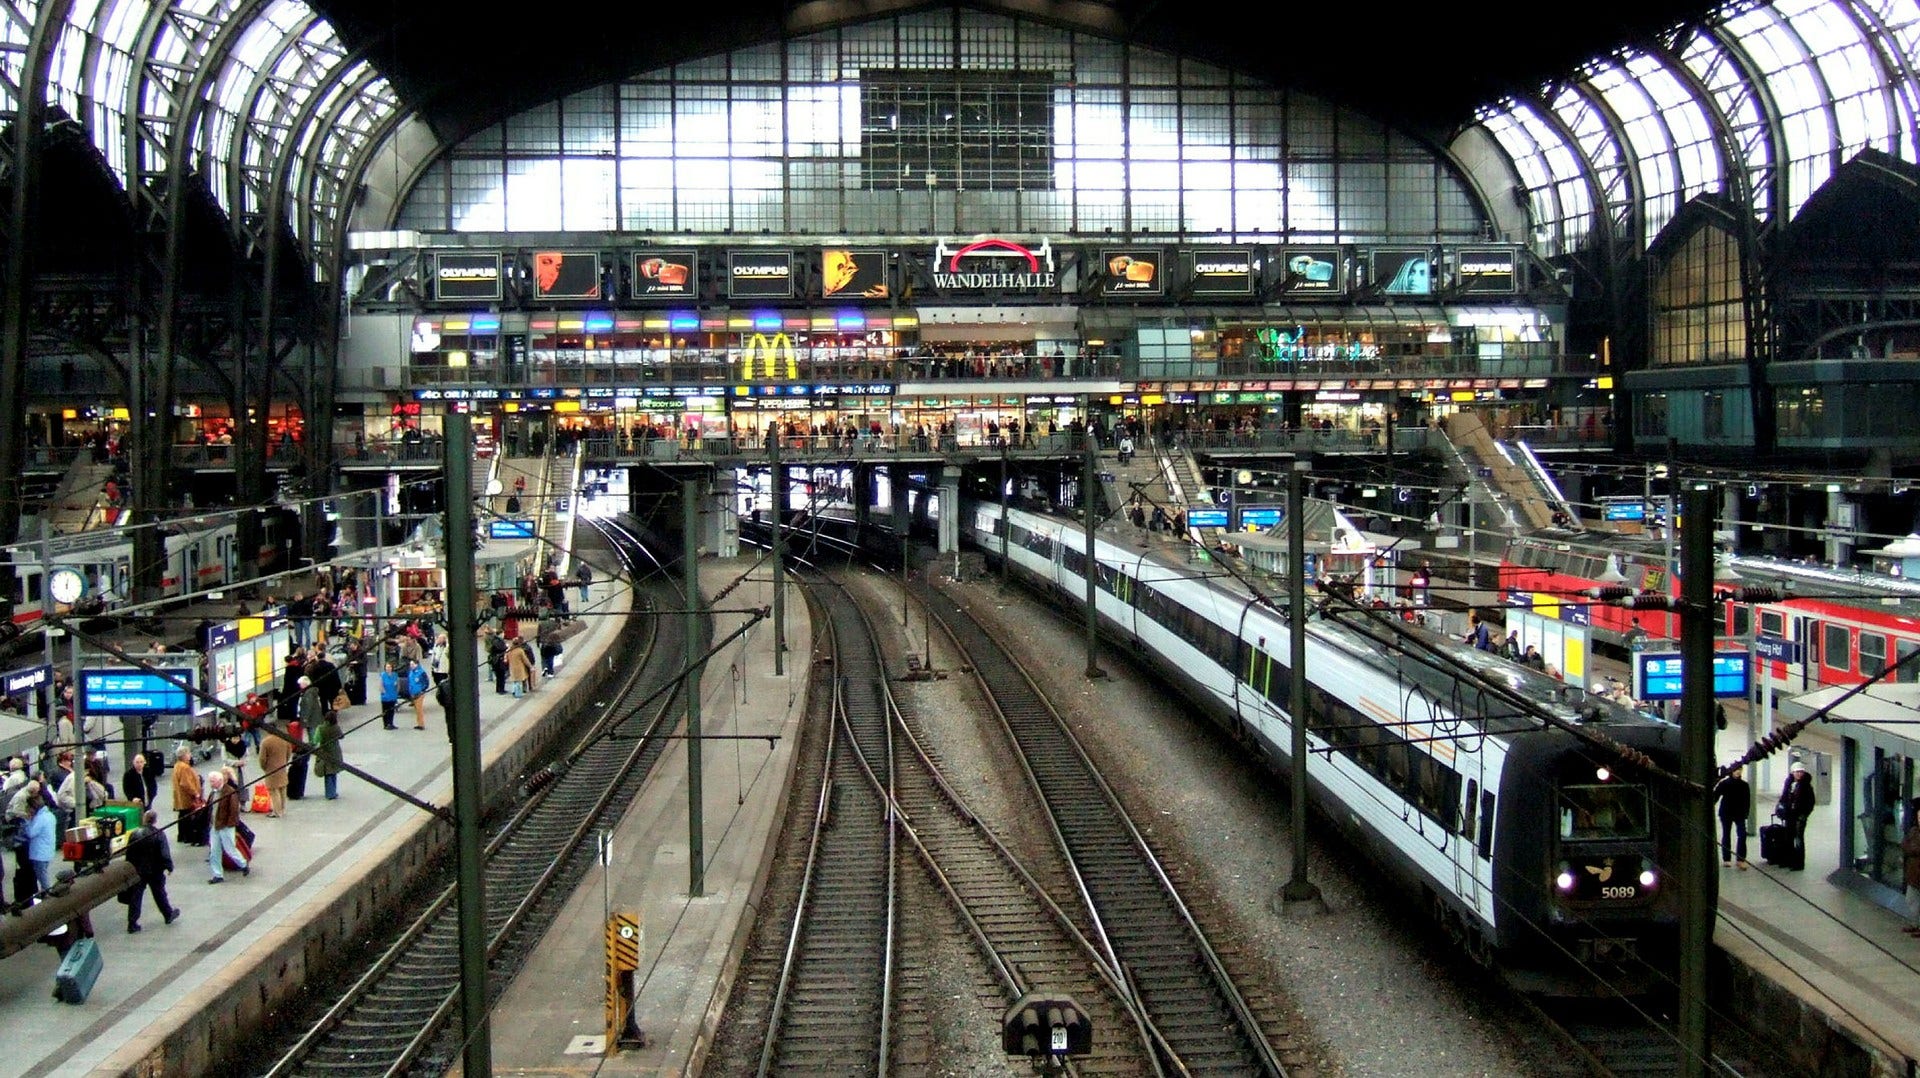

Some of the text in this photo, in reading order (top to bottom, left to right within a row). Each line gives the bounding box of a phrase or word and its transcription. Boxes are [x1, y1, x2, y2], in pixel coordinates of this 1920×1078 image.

[440, 267, 497, 277] OLYMPUS
[733, 265, 789, 275] OLYMPUS
[1195, 263, 1249, 273] OLYMPUS
[1461, 263, 1512, 272] OLYMPUS
[933, 273, 1055, 288] WANDELHALLE
[1399, 489, 1407, 502] C
[1748, 485, 1756, 496] D
[1220, 491, 1229, 503] C
[561, 499, 568, 510] E
[1851, 635, 1858, 648] 2
[1772, 644, 1783, 656] Hbf
[1602, 886, 1635, 899] 5089
